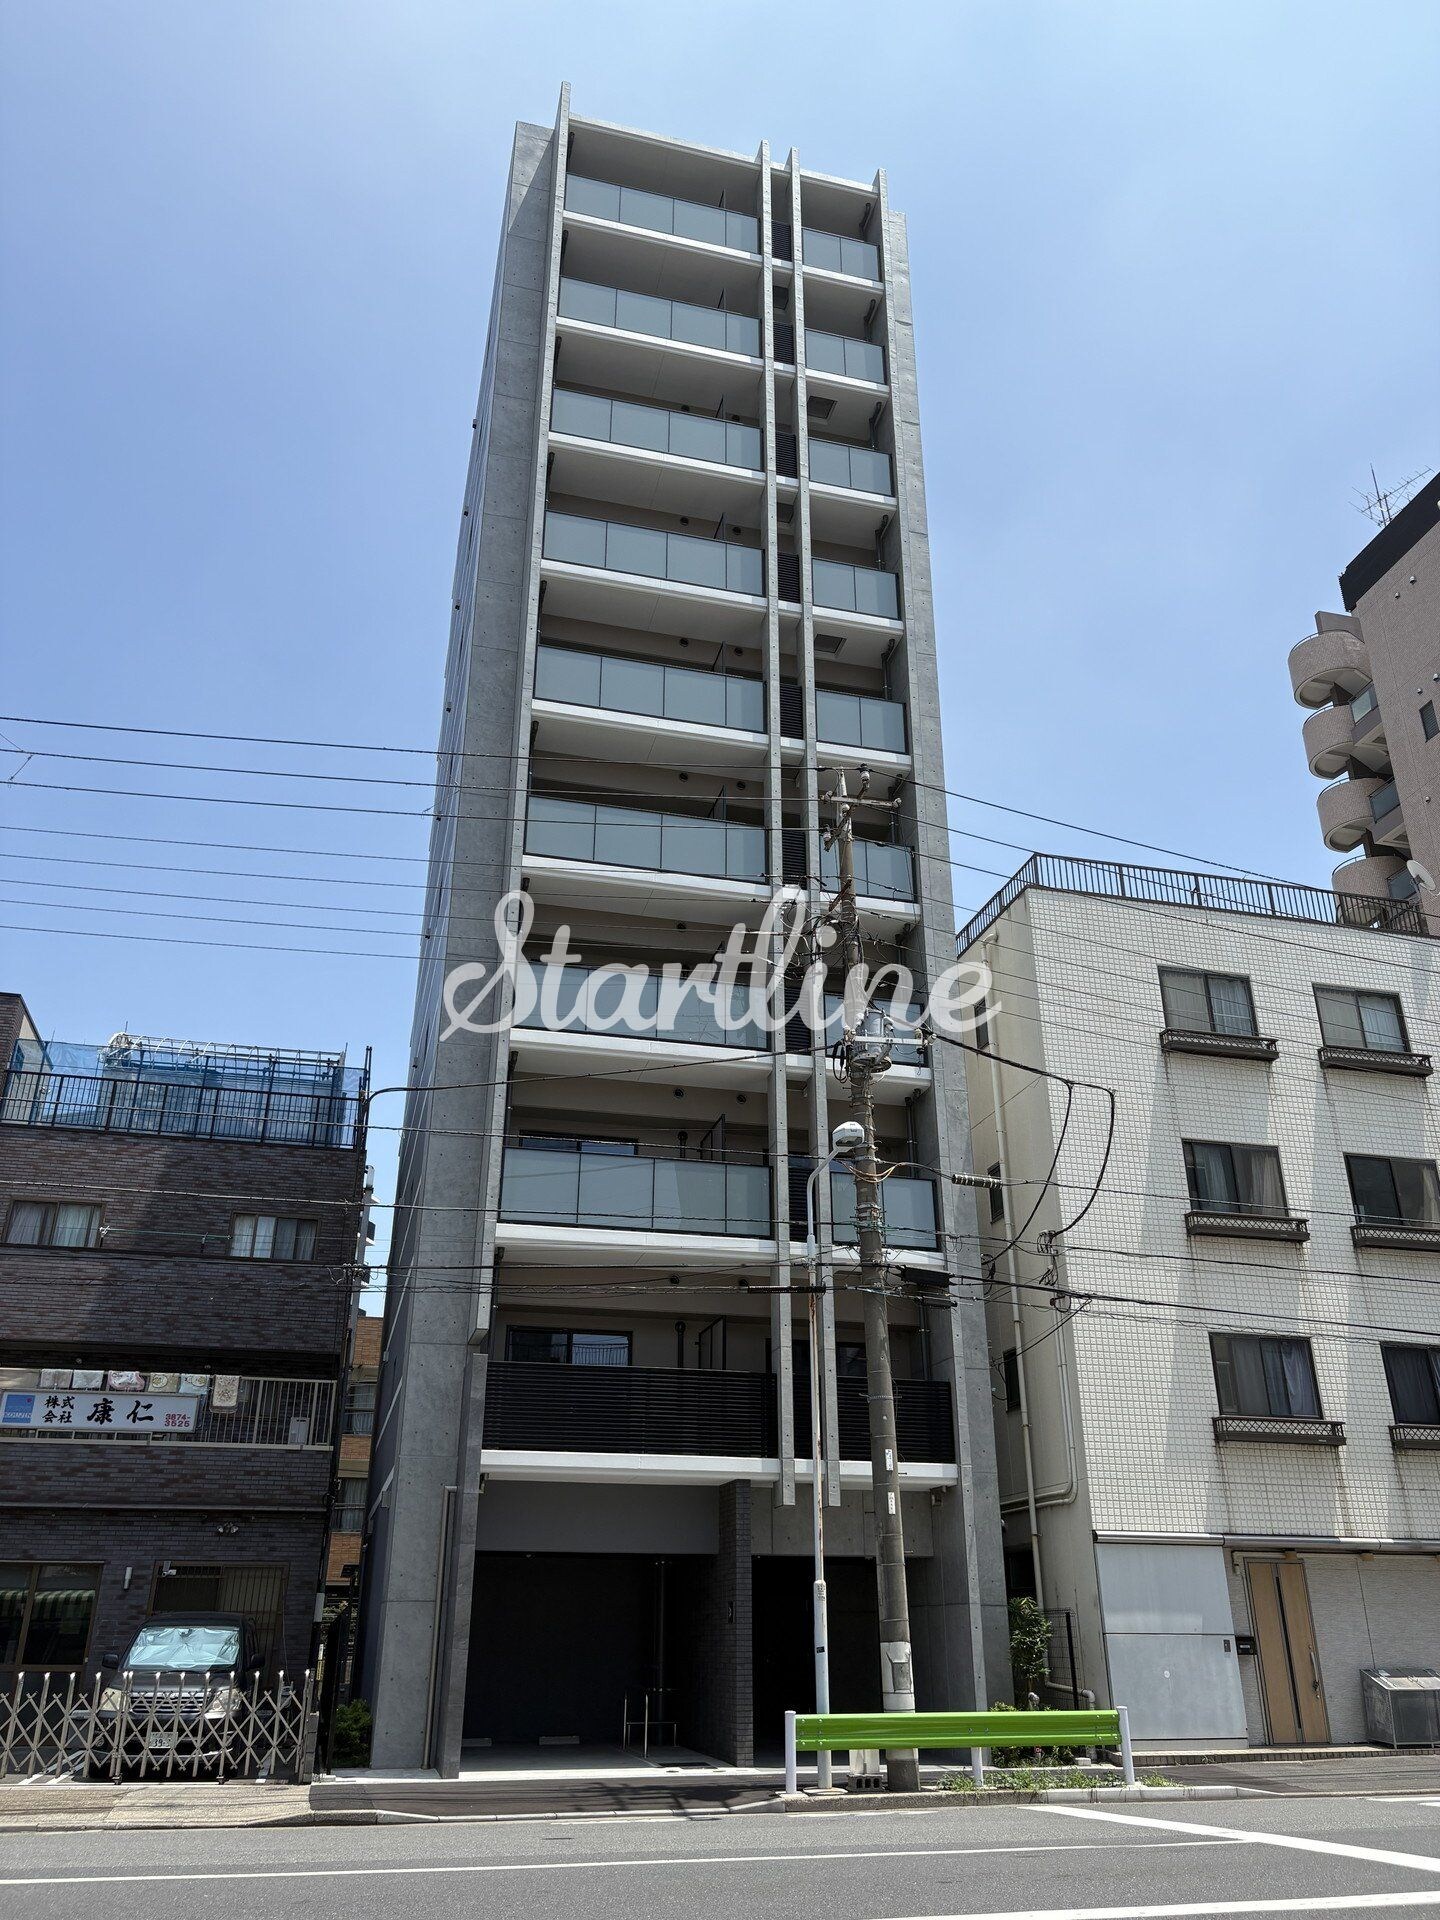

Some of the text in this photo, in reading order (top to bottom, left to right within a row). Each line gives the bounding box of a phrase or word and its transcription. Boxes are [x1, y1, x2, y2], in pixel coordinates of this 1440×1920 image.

[44, 1395, 76, 1410] 株式
[42, 1409, 73, 1424] 会社
[86, 1397, 155, 1425] 康仁
